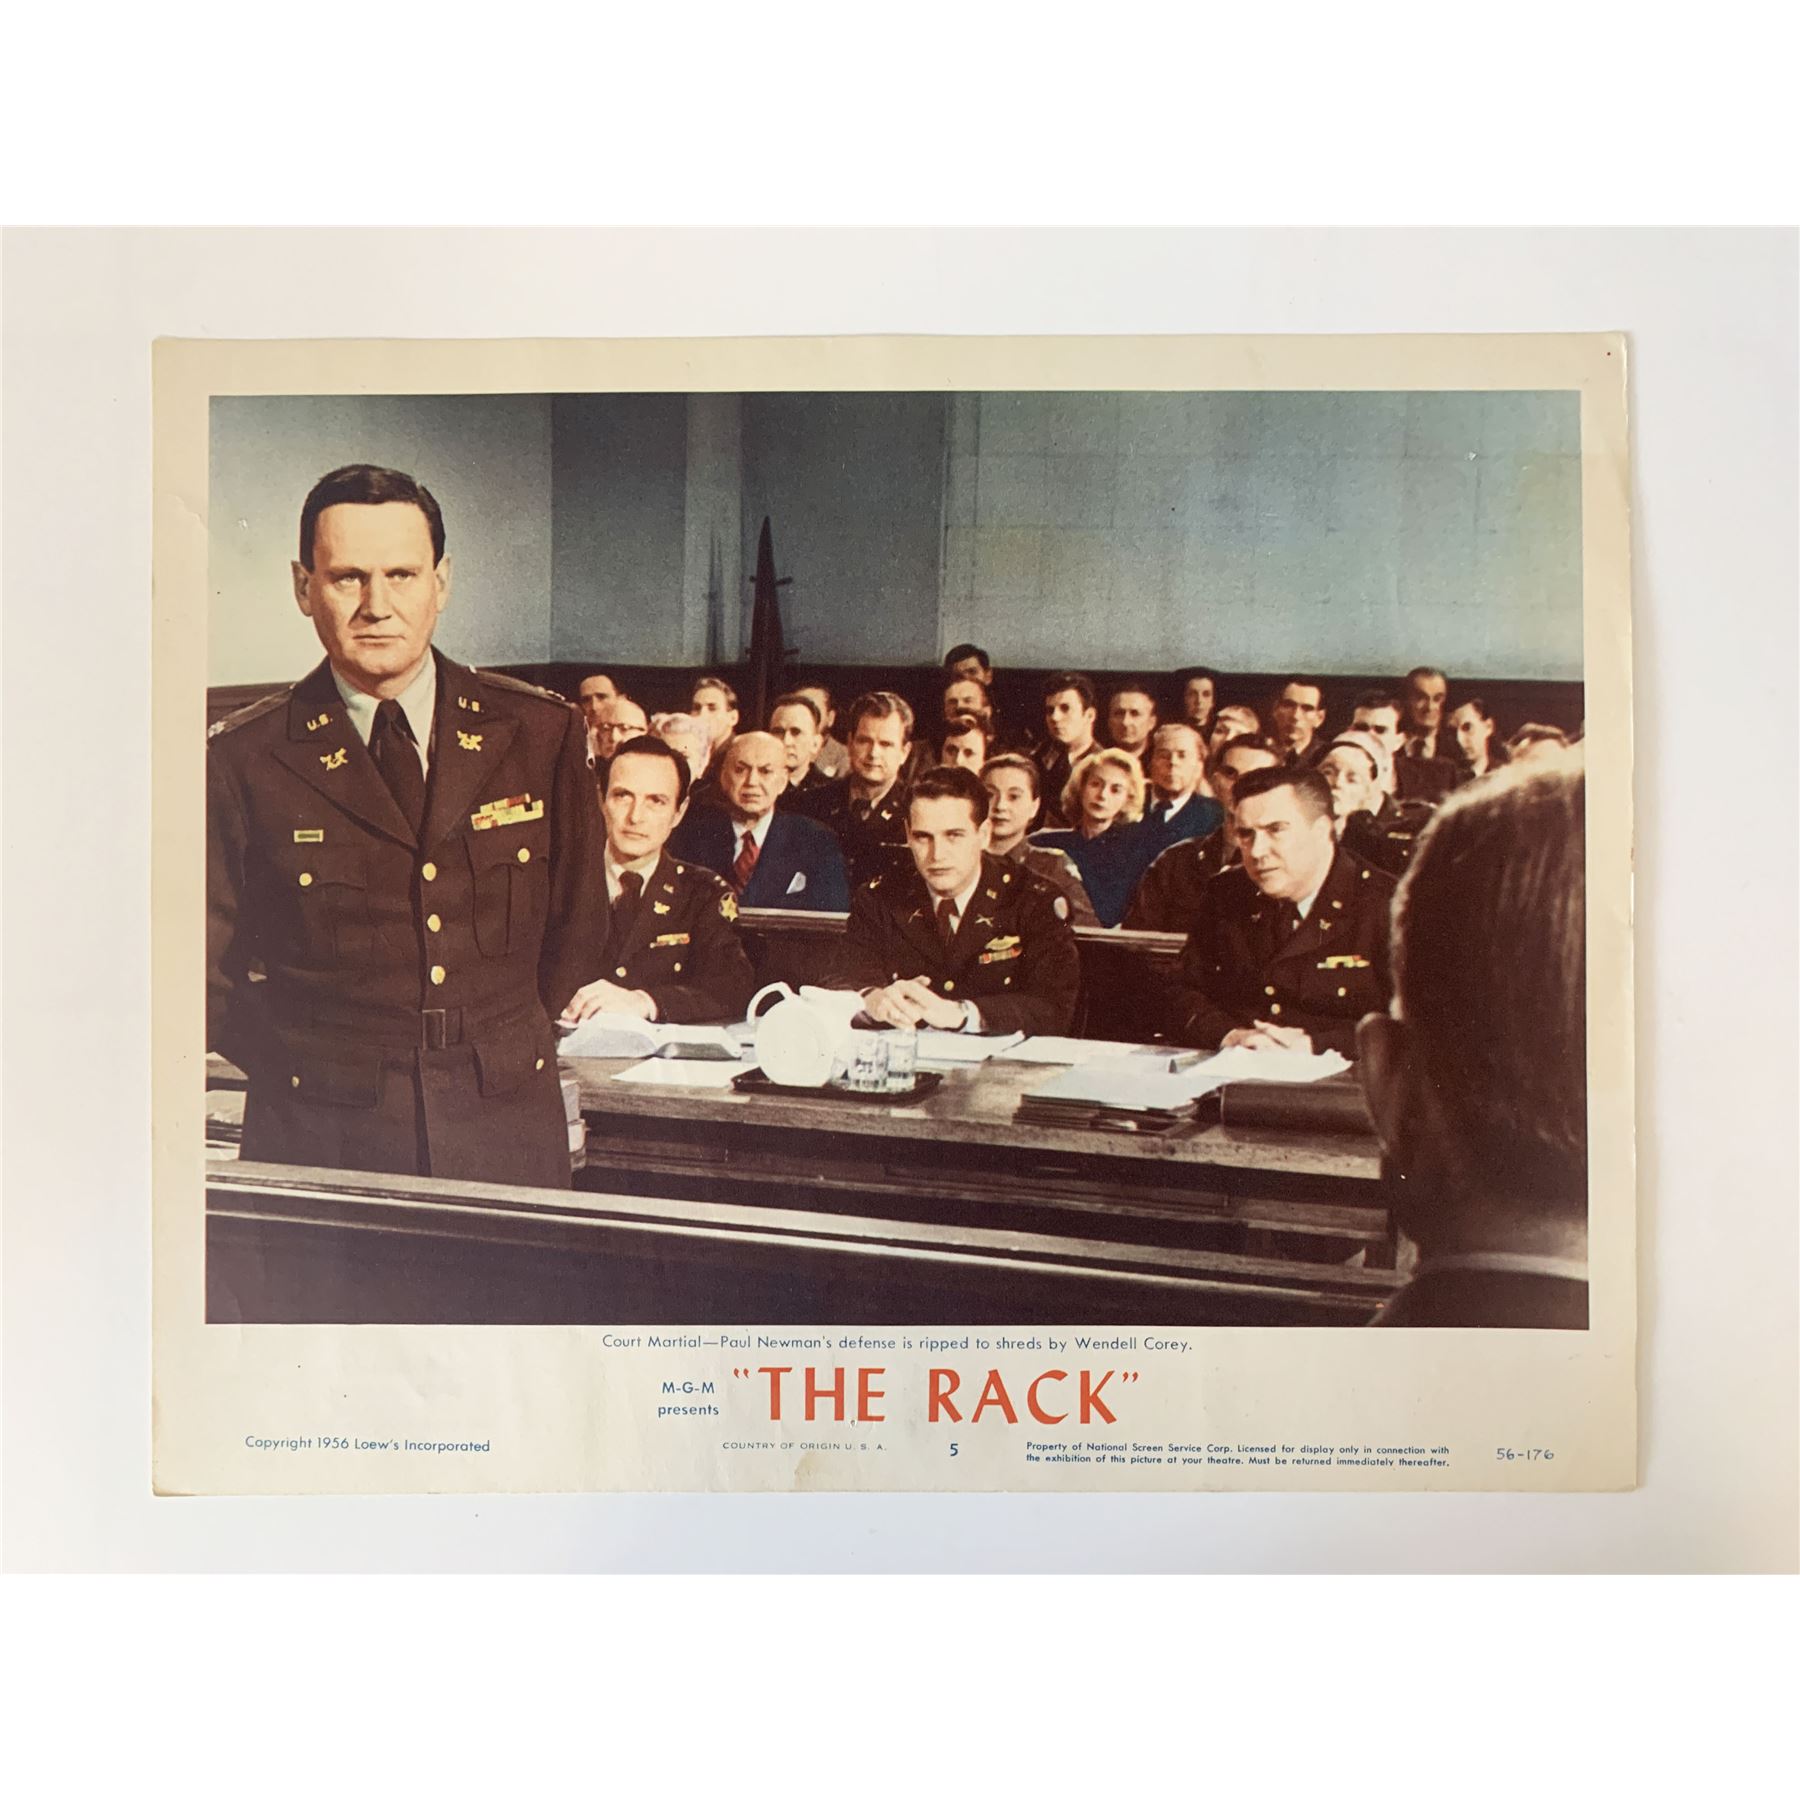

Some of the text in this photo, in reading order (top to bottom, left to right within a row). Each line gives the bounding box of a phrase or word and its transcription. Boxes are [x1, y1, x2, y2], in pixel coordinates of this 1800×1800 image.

[602, 1335, 641, 1349] Court
[757, 1335, 833, 1350] Newman's
[838, 1336, 896, 1350] defense
[903, 1336, 912, 1351] is
[919, 1336, 968, 1354] ripped
[976, 1337, 991, 1352] to
[996, 1337, 1042, 1352] shreds
[1048, 1337, 1068, 1356] by
[1074, 1337, 1137, 1352] Wendell
[1143, 1338, 1193, 1356] Corey.
[661, 1381, 715, 1396] M-G-M
[658, 1404, 720, 1419] presents
[245, 1436, 490, 1454] Copyright 1956 Loew's Incorporated
[722, 1441, 775, 1450] COUNTRY
[780, 1442, 795, 1450] OF
[800, 1442, 840, 1451] ORIGIN
[949, 1442, 960, 1458] 5
[1026, 1441, 1450, 1456] Property of National Screen Service Corp. Licensed for display only in connection with
[1026, 1454, 1450, 1468] the exhibition of this picture at your theatre. Must be returned immediately thereafter.
[1496, 1447, 1555, 1462] 56-176
